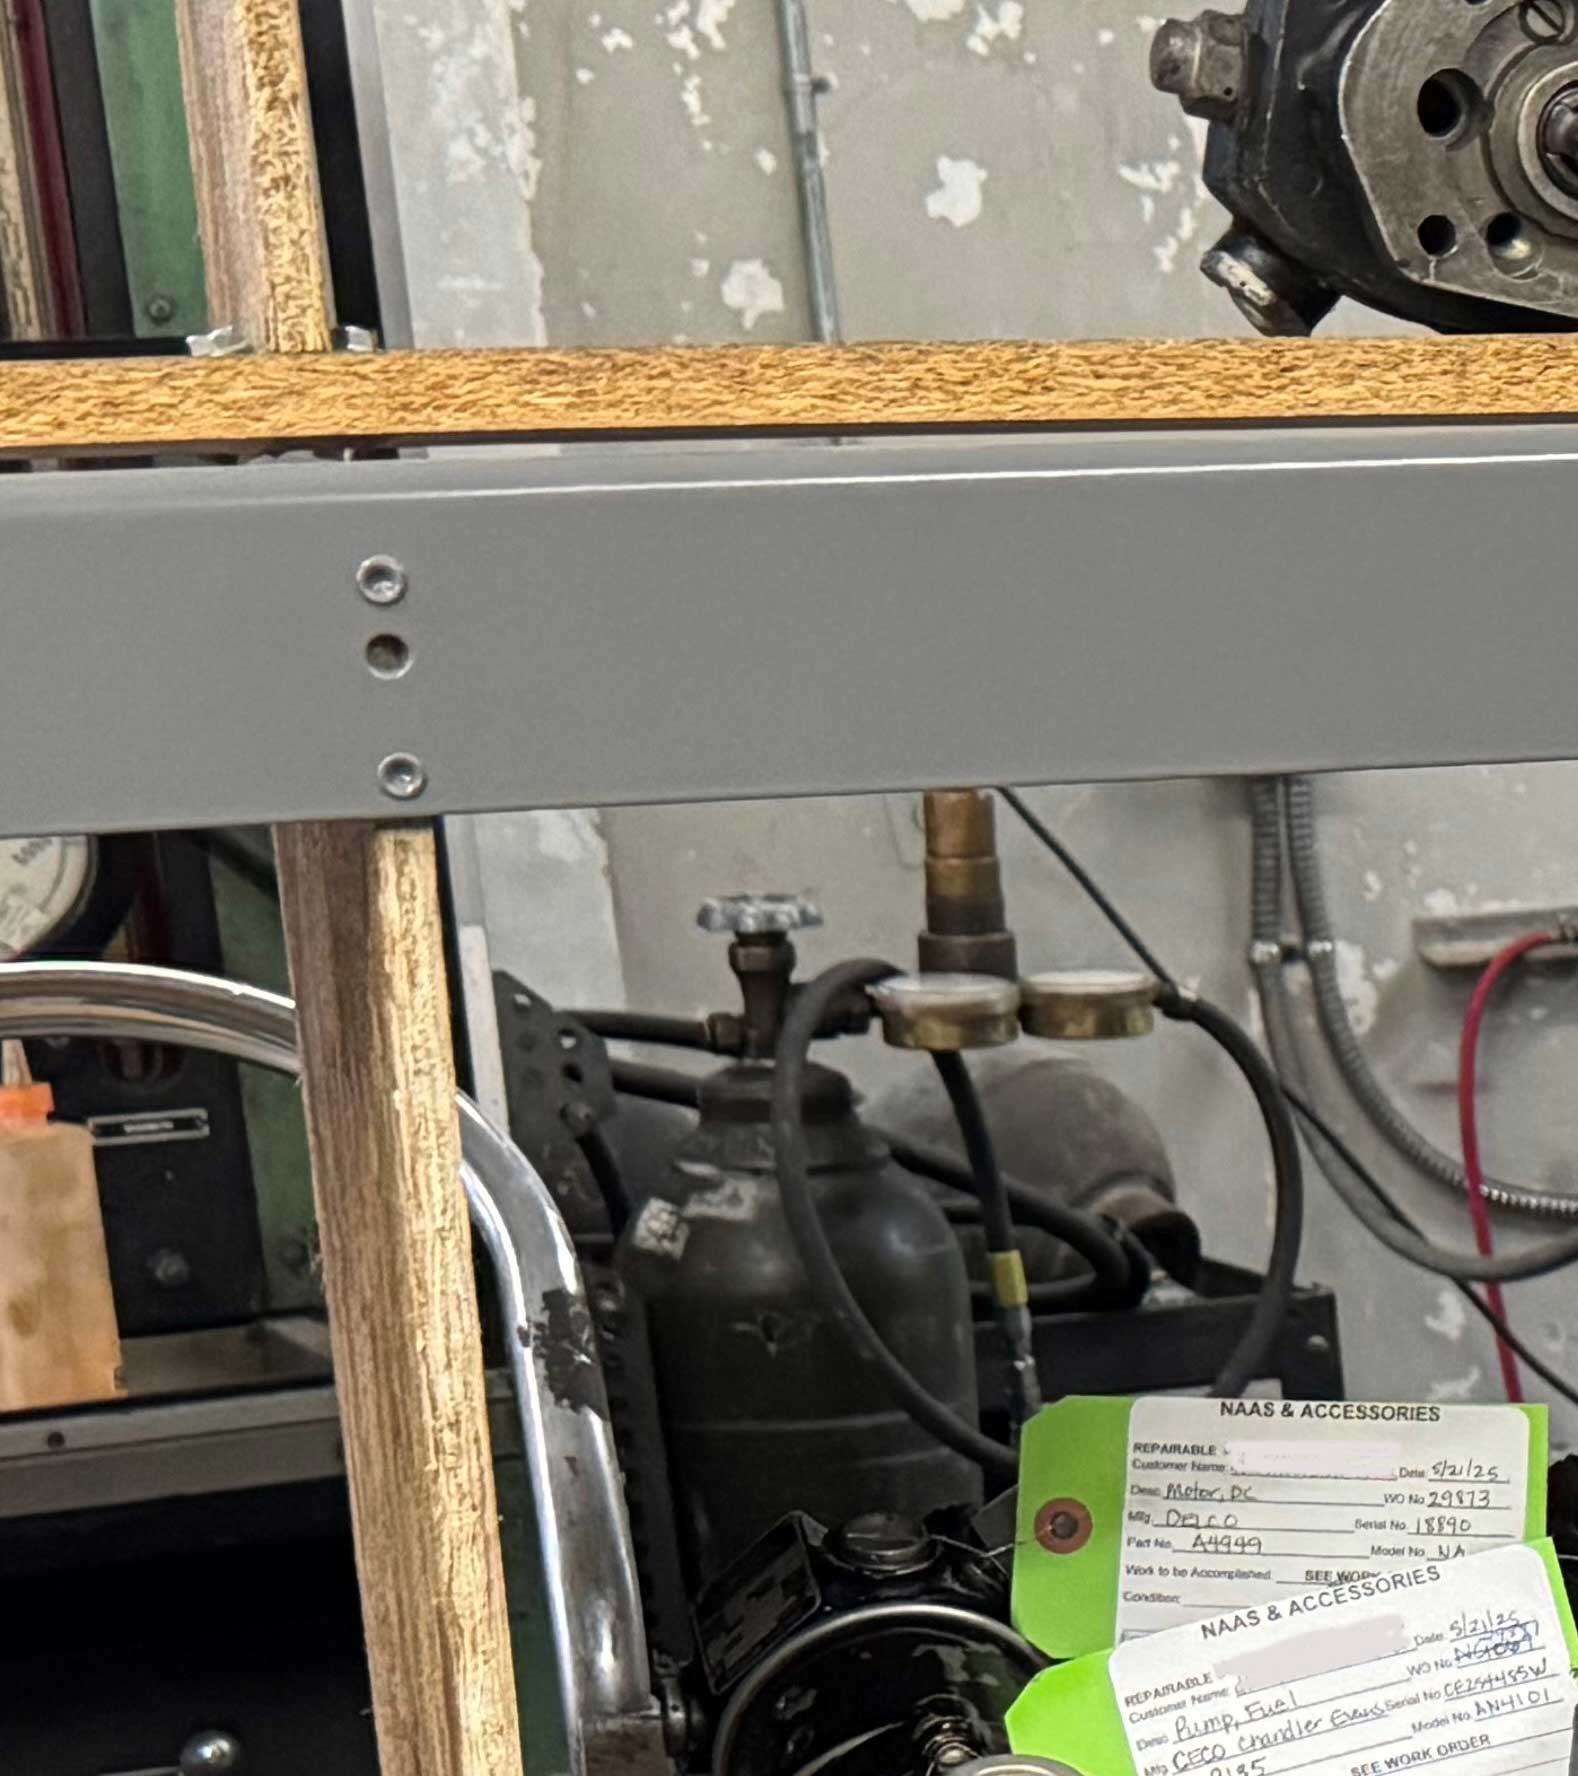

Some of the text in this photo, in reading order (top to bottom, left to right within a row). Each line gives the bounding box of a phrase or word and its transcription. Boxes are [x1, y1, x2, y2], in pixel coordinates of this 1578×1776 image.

[1220, 1402, 1441, 1422] NAAS & ACCESSORIES
[1133, 1442, 1217, 1456] REPAIRABLE
[1431, 1458, 1499, 1481] 5/21/25
[1230, 1485, 1257, 1500] DC
[1428, 1489, 1491, 1508] 29873
[1158, 1566, 1170, 1576] to
[1173, 1566, 1188, 1577] be
[1305, 1570, 1333, 1582] SEE
[1201, 1565, 1441, 1639] NAAS & ACCESSORIES
[1449, 1610, 1521, 1639] 5/21/25
[1124, 1672, 1213, 1707] REPAIRABLE
[1475, 1688, 1550, 1717] AN4101
[1128, 1698, 1187, 1724] Customer
[1245, 1690, 1298, 1718] Fuel
[1172, 1744, 1227, 1773] CECO
[1238, 1715, 1323, 1753] Chandler
[1384, 1748, 1433, 1770] WORK
[1437, 1734, 1491, 1757] ORDER
